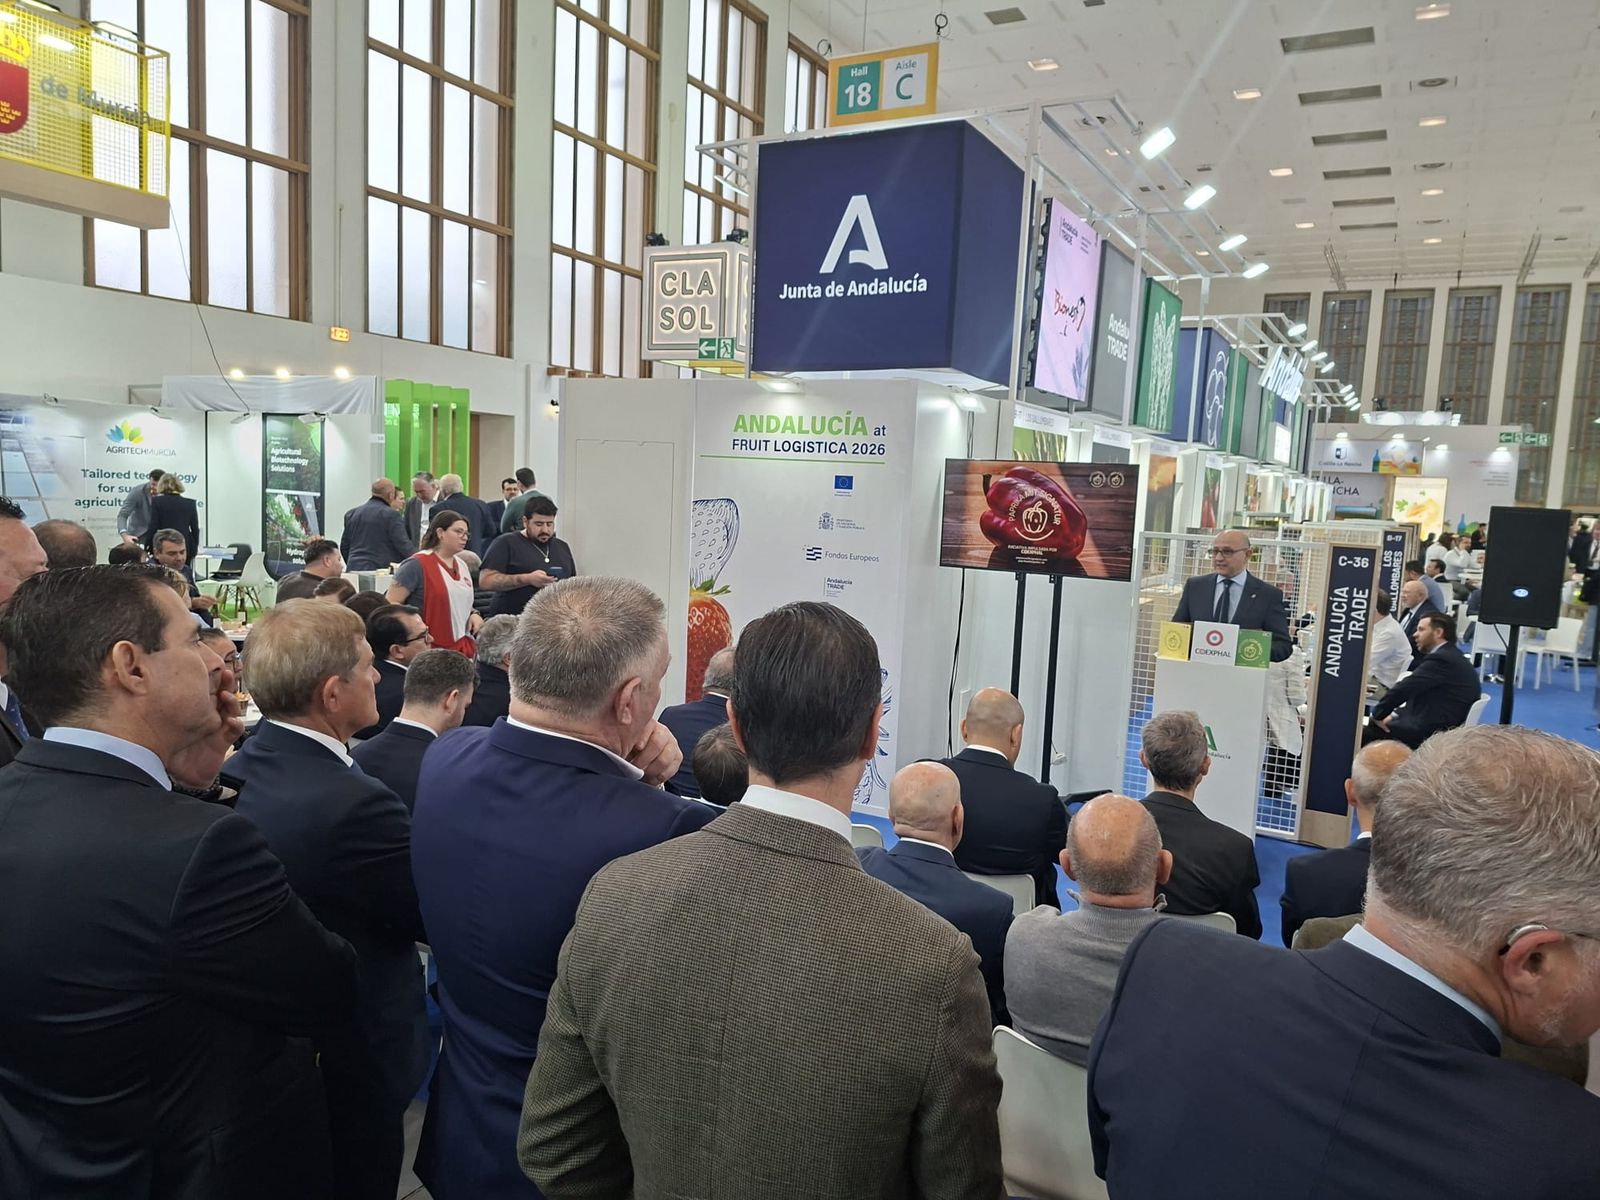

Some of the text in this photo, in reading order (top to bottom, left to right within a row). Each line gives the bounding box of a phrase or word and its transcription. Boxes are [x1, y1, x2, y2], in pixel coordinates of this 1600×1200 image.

[850, 66, 869, 77] Hall
[895, 60, 917, 70] Aisle
[40, 74, 69, 99] de
[845, 82, 872, 108] 18
[895, 73, 914, 100] C
[661, 271, 714, 297] CLA
[779, 273, 928, 299] Junta de Andalucía
[660, 306, 713, 331] SOL
[1108, 313, 1130, 340] Andalu
[1107, 335, 1128, 361] TRADE
[733, 411, 886, 436] ANDALUCÍA at
[106, 446, 177, 456] AGRITECHMURCIA
[271, 448, 302, 456] Agricultural
[732, 439, 886, 456] FRUIT LOGISTICA 2026
[271, 456, 309, 466] Biotechnology
[81, 469, 198, 484] Tailored tecogy
[98, 483, 115, 493] for
[75, 498, 126, 508] agricult
[825, 550, 880, 563] Fondos Europeos
[1338, 555, 1369, 568] C-36
[1383, 550, 1393, 567] LOS
[1348, 587, 1369, 640] TRADE
[1324, 586, 1350, 677] ANDALUCÍA
[1194, 648, 1232, 658] COEXPHAL
